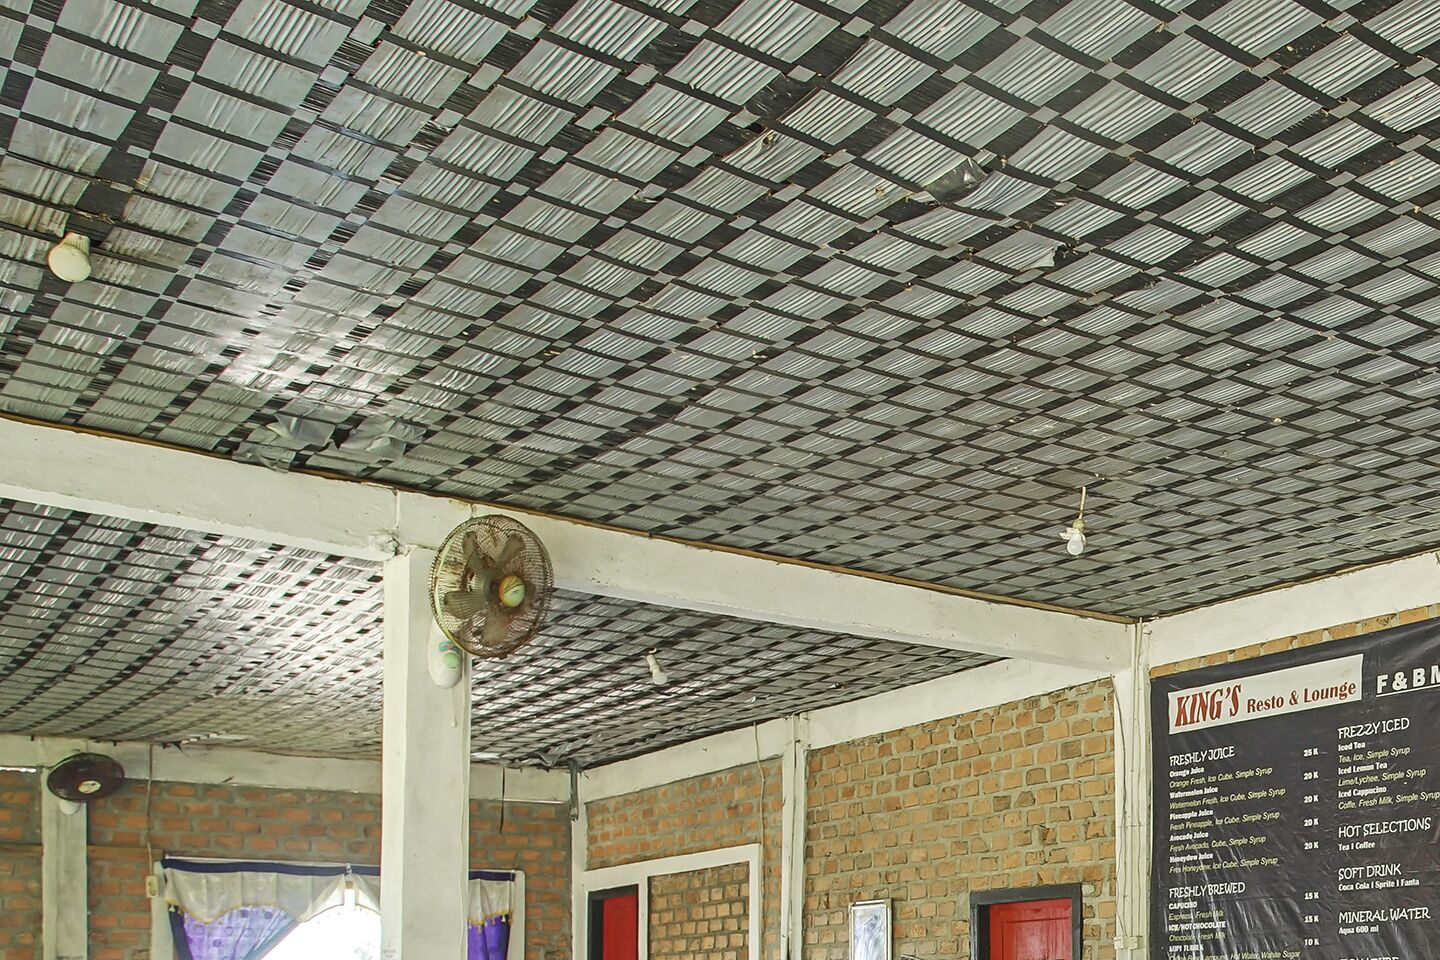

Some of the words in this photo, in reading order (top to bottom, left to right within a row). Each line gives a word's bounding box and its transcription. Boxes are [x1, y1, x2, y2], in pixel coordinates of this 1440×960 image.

[1377, 675, 1388, 694] F
[1392, 672, 1407, 690] &
[1413, 668, 1425, 687] B
[1175, 684, 1241, 727] KING'S
[1247, 696, 1284, 713] Resto
[1289, 690, 1299, 705] &
[1303, 681, 1356, 703] Lounge
[1338, 722, 1382, 739] FREZZY
[1382, 717, 1410, 732] ICED
[1338, 743, 1352, 751] Iced
[1367, 750, 1388, 760] Simple
[1391, 747, 1410, 757] Syrup
[1170, 751, 1208, 766] FRESHLY
[1208, 746, 1235, 761] JUICE
[1255, 767, 1272, 776] Syrup
[1338, 766, 1351, 775] Iced
[1353, 765, 1374, 773] Lemon
[1376, 762, 1387, 770] Tea
[1382, 772, 1404, 781] Simple
[1406, 769, 1426, 778] Syrup
[1268, 788, 1286, 797] Syrup
[1338, 790, 1351, 798] Iced
[1359, 799, 1377, 807] Fresh
[1396, 794, 1418, 803] Simple
[1263, 811, 1280, 821] Syrup
[1339, 825, 1362, 838] HOT
[1363, 817, 1431, 837] SELECTIONS
[1249, 836, 1266, 845] Syrup
[1356, 841, 1375, 849] Coffee
[1339, 867, 1364, 881] SOFT
[1367, 864, 1402, 878] DRINK
[1169, 885, 1208, 898] FRESHLY
[1208, 882, 1245, 895] BREWED
[1338, 883, 1354, 891] Coca
[1355, 882, 1369, 890] Cola
[1375, 880, 1395, 889] Sprite
[1401, 878, 1419, 886] Fanta
[1305, 892, 1313, 900] 15
[1313, 891, 1319, 899] K
[1339, 910, 1388, 924] MINERAL
[1390, 907, 1431, 920] WATER
